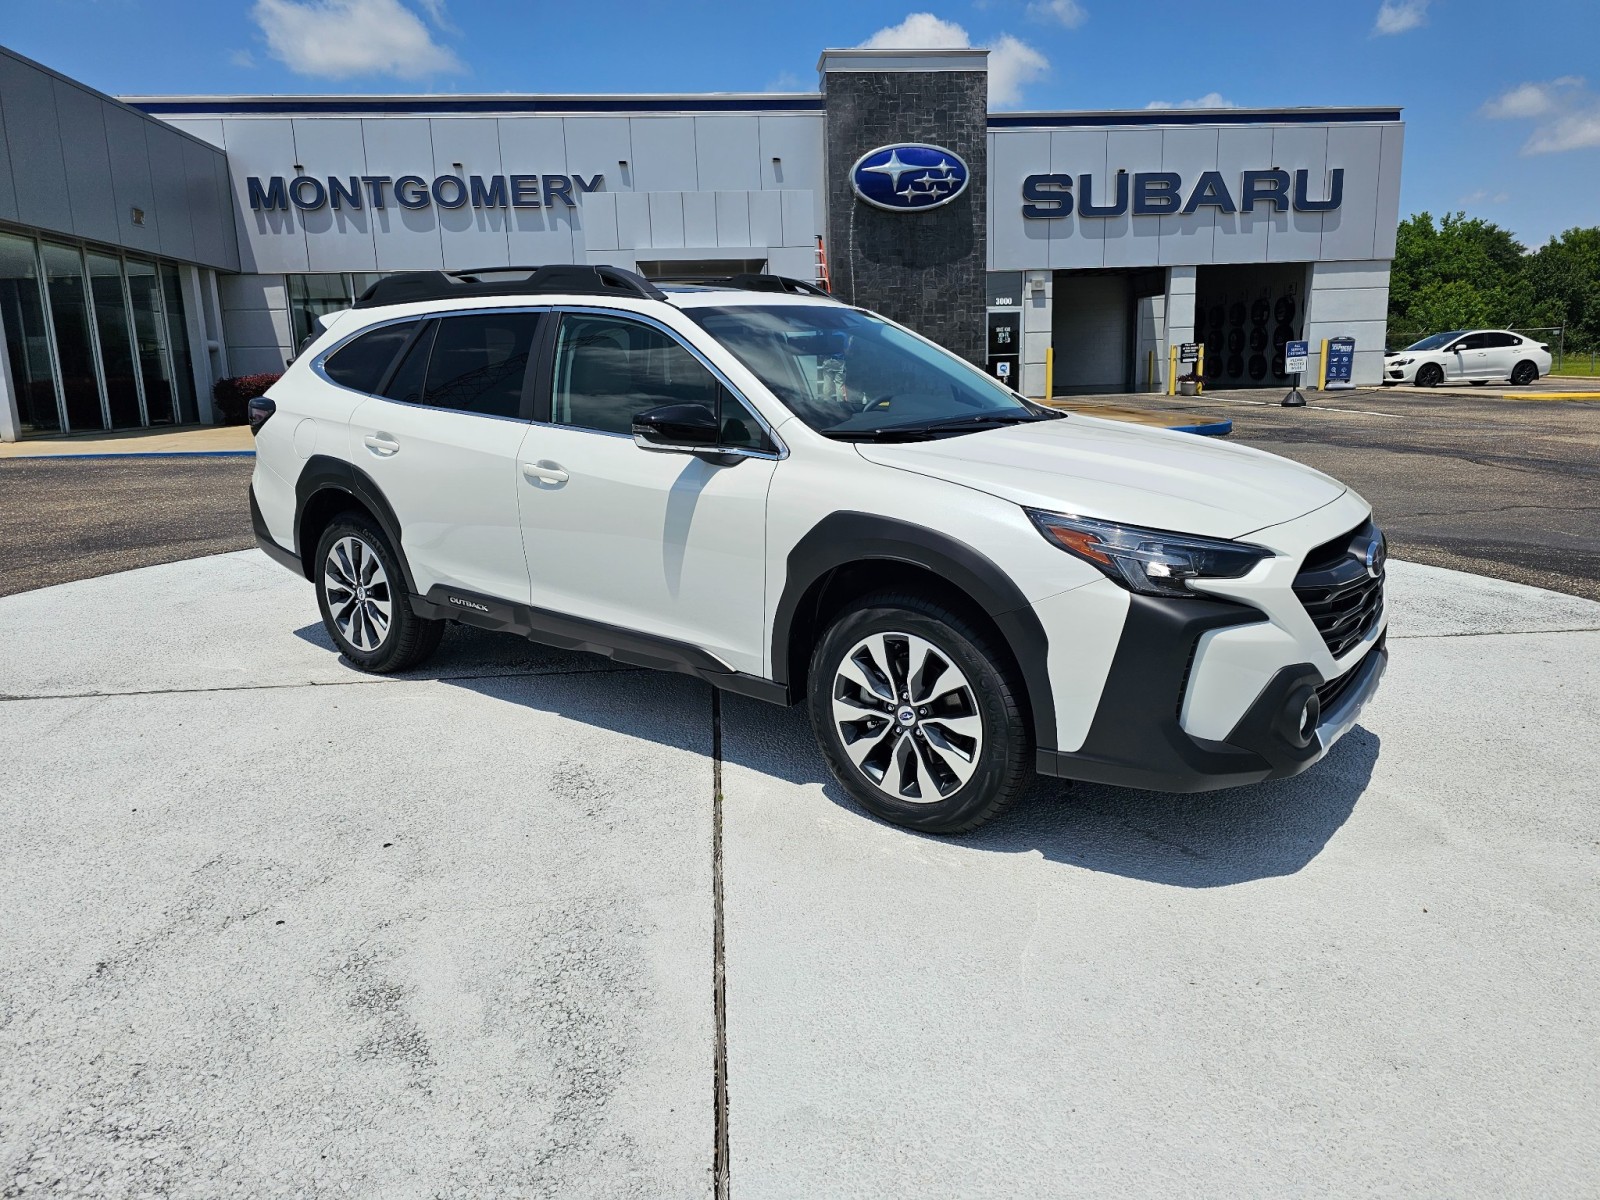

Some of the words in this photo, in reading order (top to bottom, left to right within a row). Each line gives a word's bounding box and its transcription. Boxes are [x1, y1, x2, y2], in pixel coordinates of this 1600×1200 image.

[246, 174, 603, 210] MONTGOMERY
[1022, 168, 1344, 218] SUBARU
[995, 297, 1012, 305] 3000
[449, 597, 489, 612] OUTBACK
